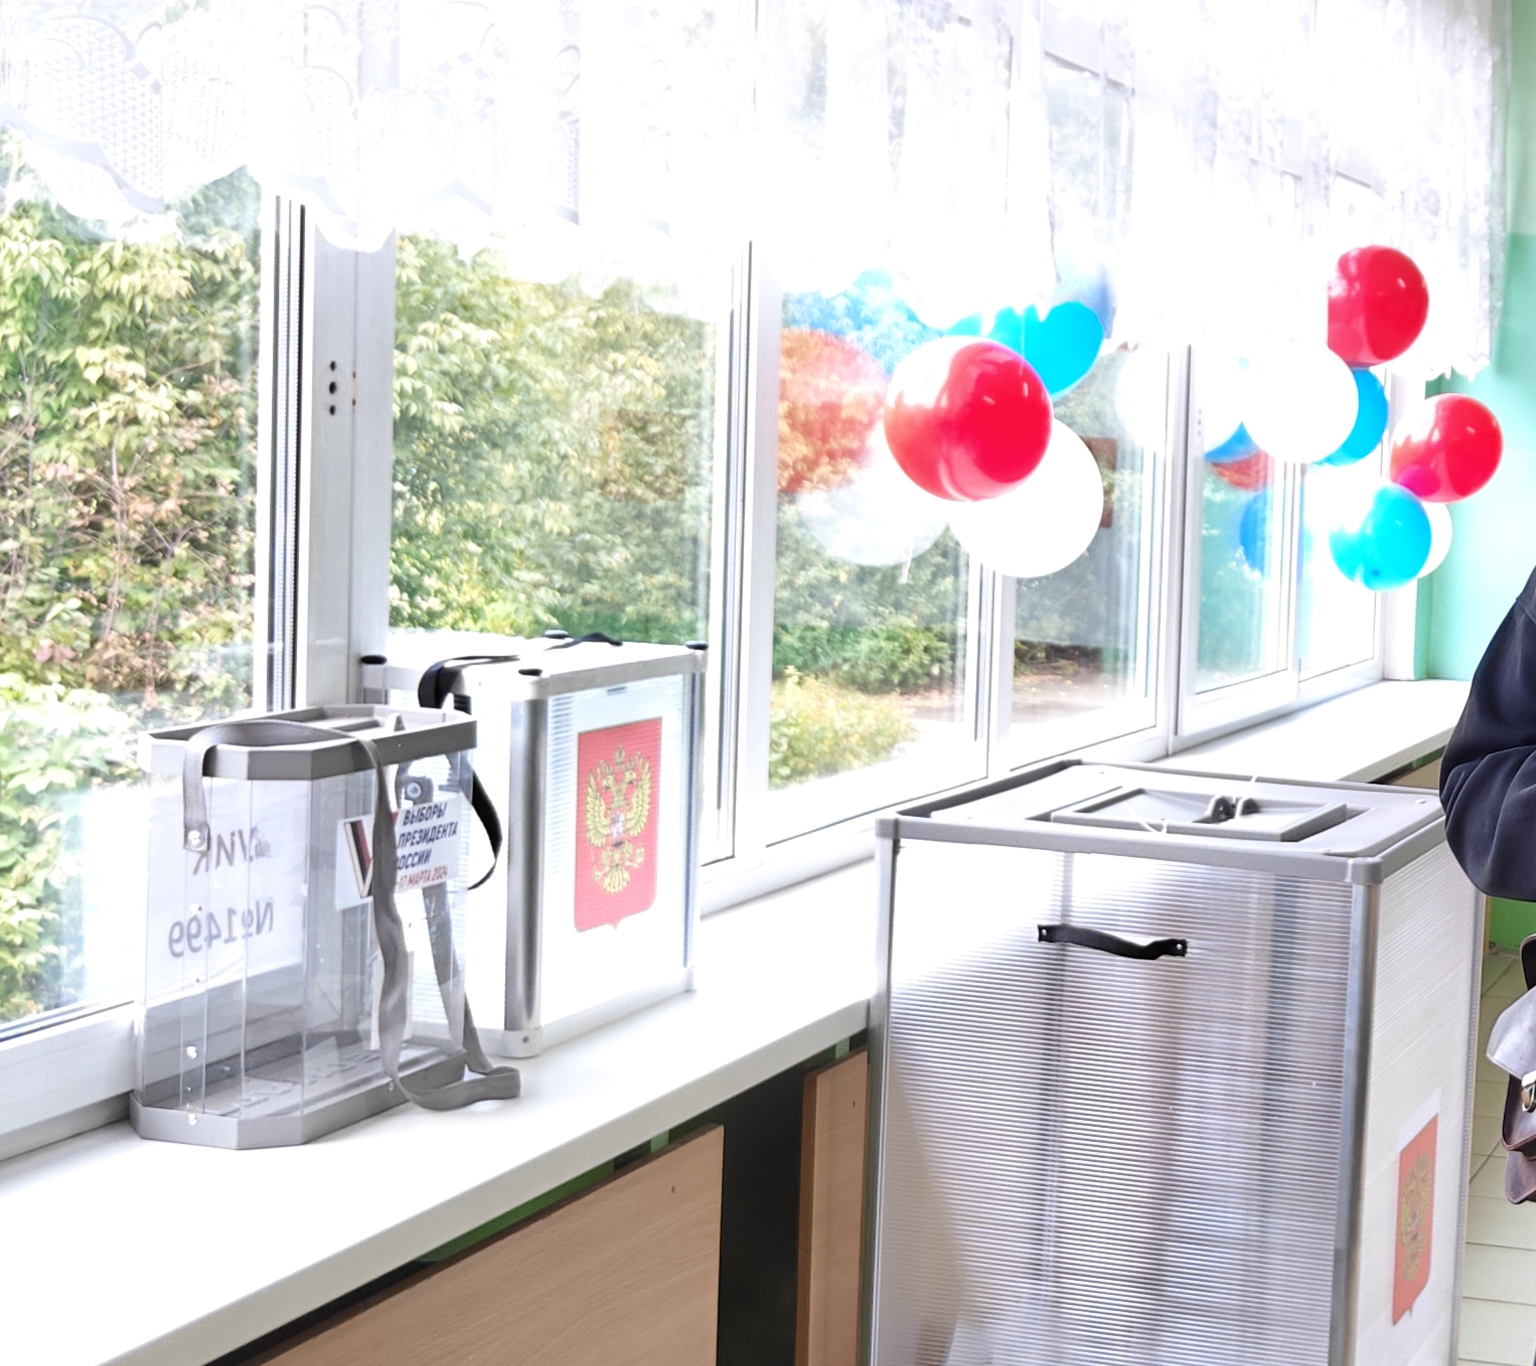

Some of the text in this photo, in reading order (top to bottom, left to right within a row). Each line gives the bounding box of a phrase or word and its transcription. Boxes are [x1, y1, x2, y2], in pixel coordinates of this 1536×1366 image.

[403, 802, 448, 826] ВЫБОРЫ
[396, 821, 459, 849] ПРЕЗИДЕНТА
[397, 849, 432, 871] ОССИИ
